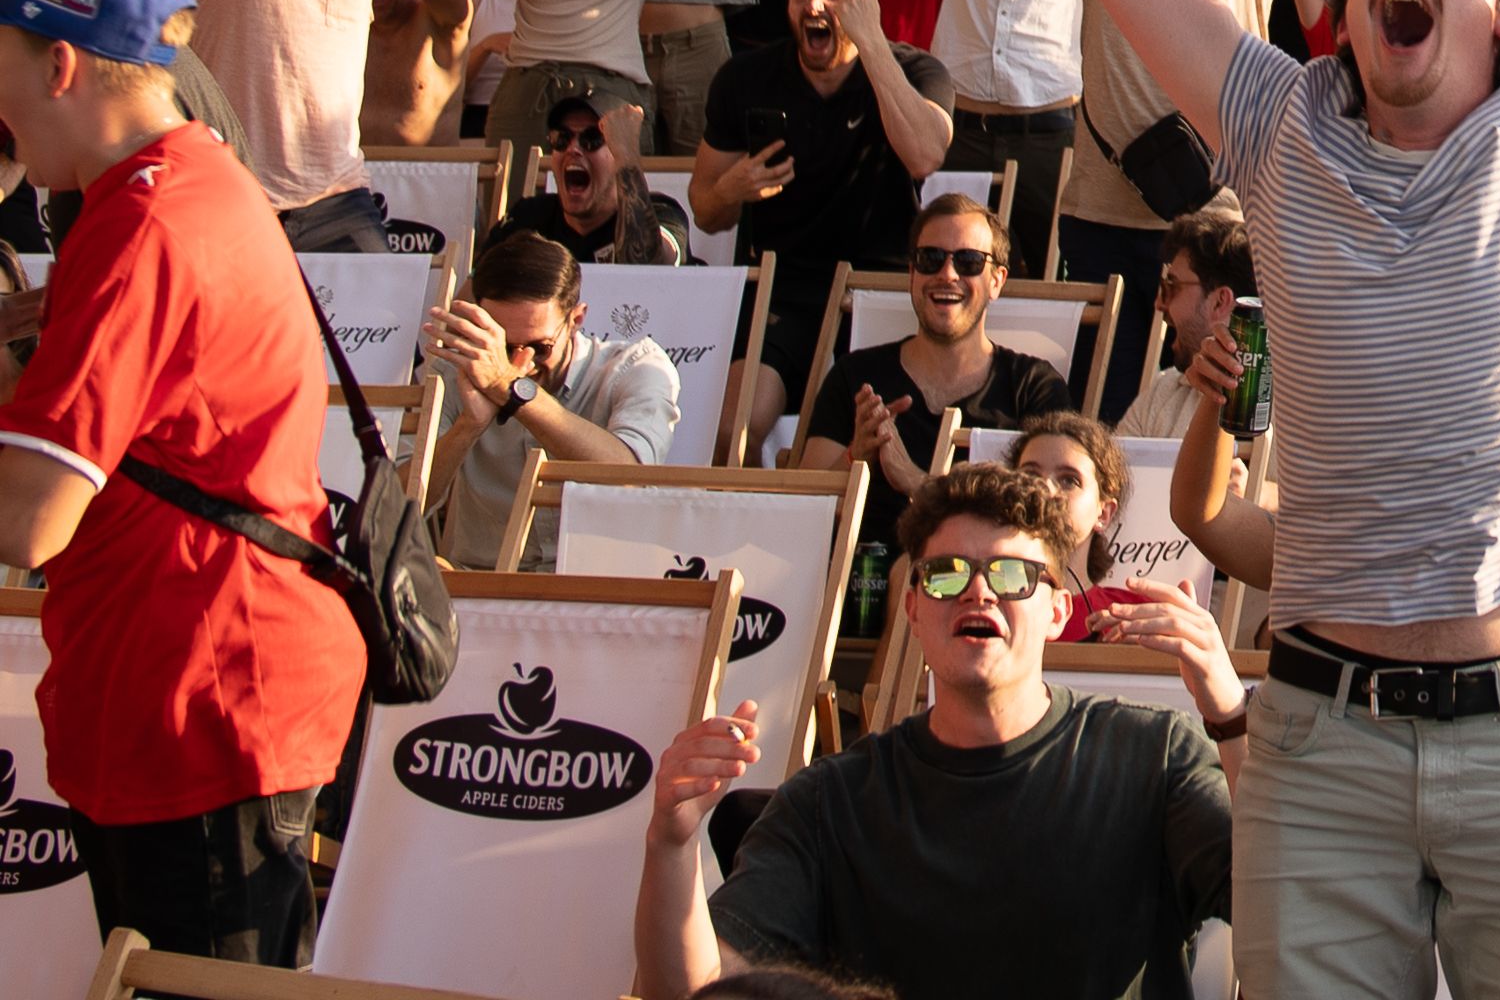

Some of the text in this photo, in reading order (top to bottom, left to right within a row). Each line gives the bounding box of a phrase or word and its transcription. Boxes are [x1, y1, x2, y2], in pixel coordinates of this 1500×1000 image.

[408, 738, 636, 789] STRONGBOW
[461, 790, 565, 812] APPLE CIDERS
[0, 828, 79, 864] BOW
